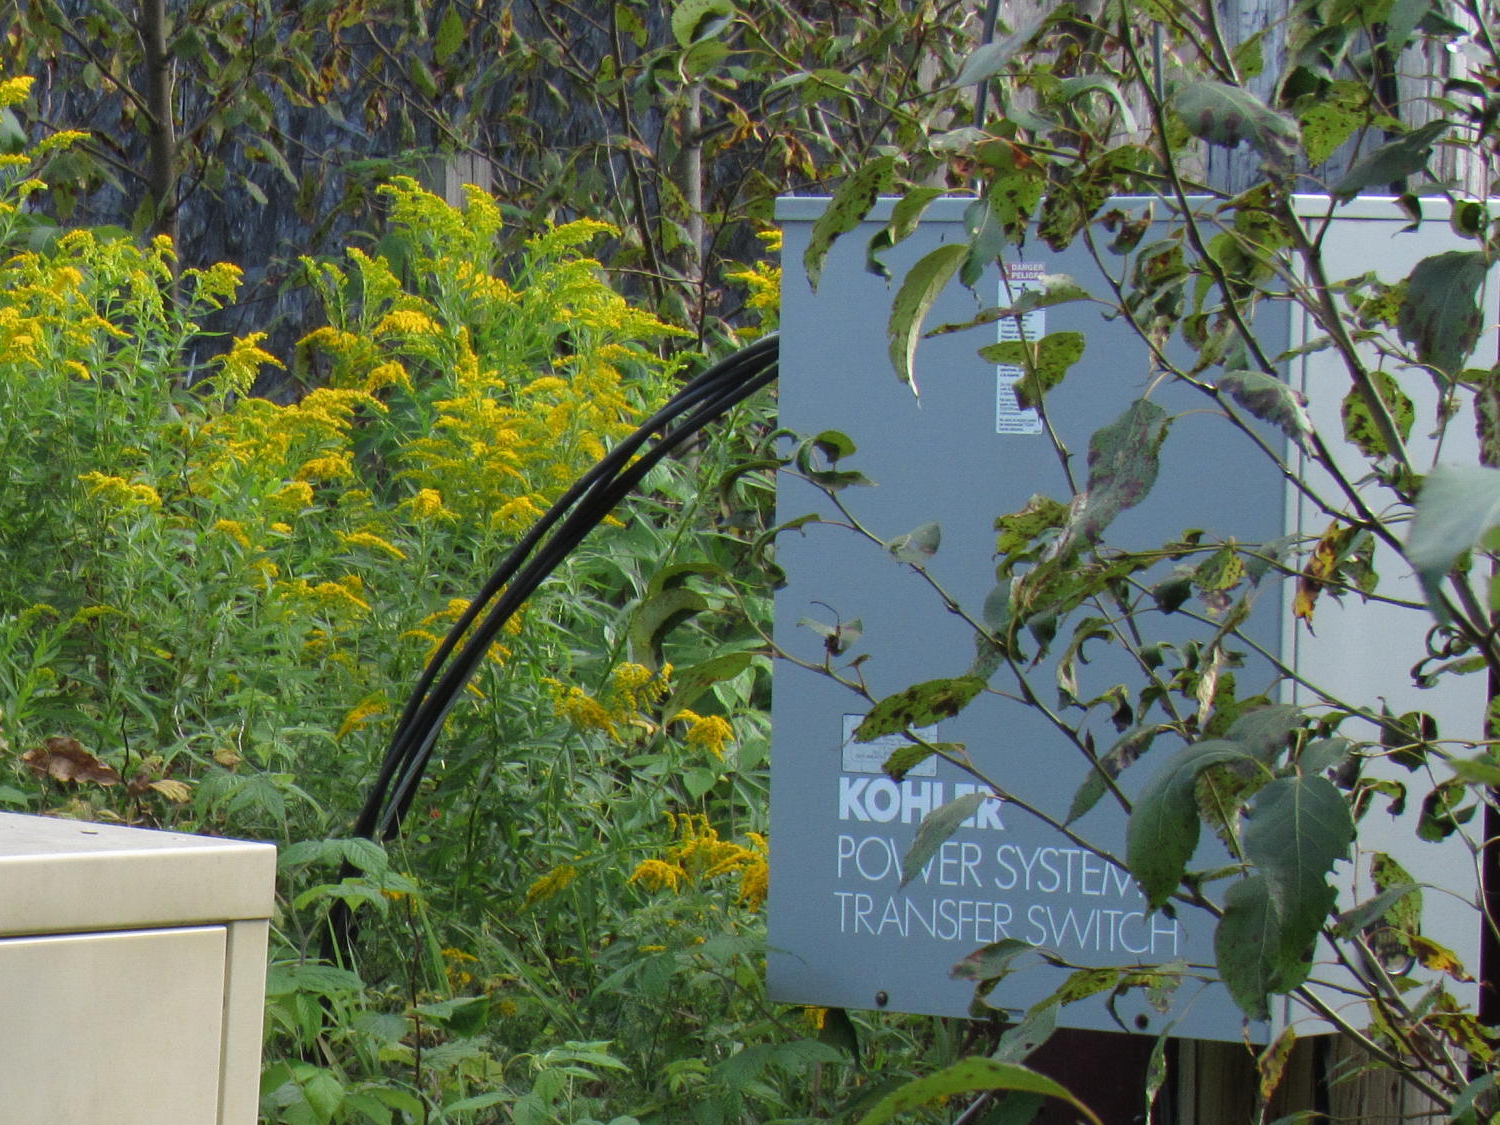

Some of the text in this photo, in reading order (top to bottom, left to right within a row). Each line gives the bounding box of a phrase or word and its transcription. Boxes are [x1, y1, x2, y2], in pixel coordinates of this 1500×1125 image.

[1011, 263, 1044, 271] DANGER
[833, 891, 1178, 956] TRANSFER SWITCH
